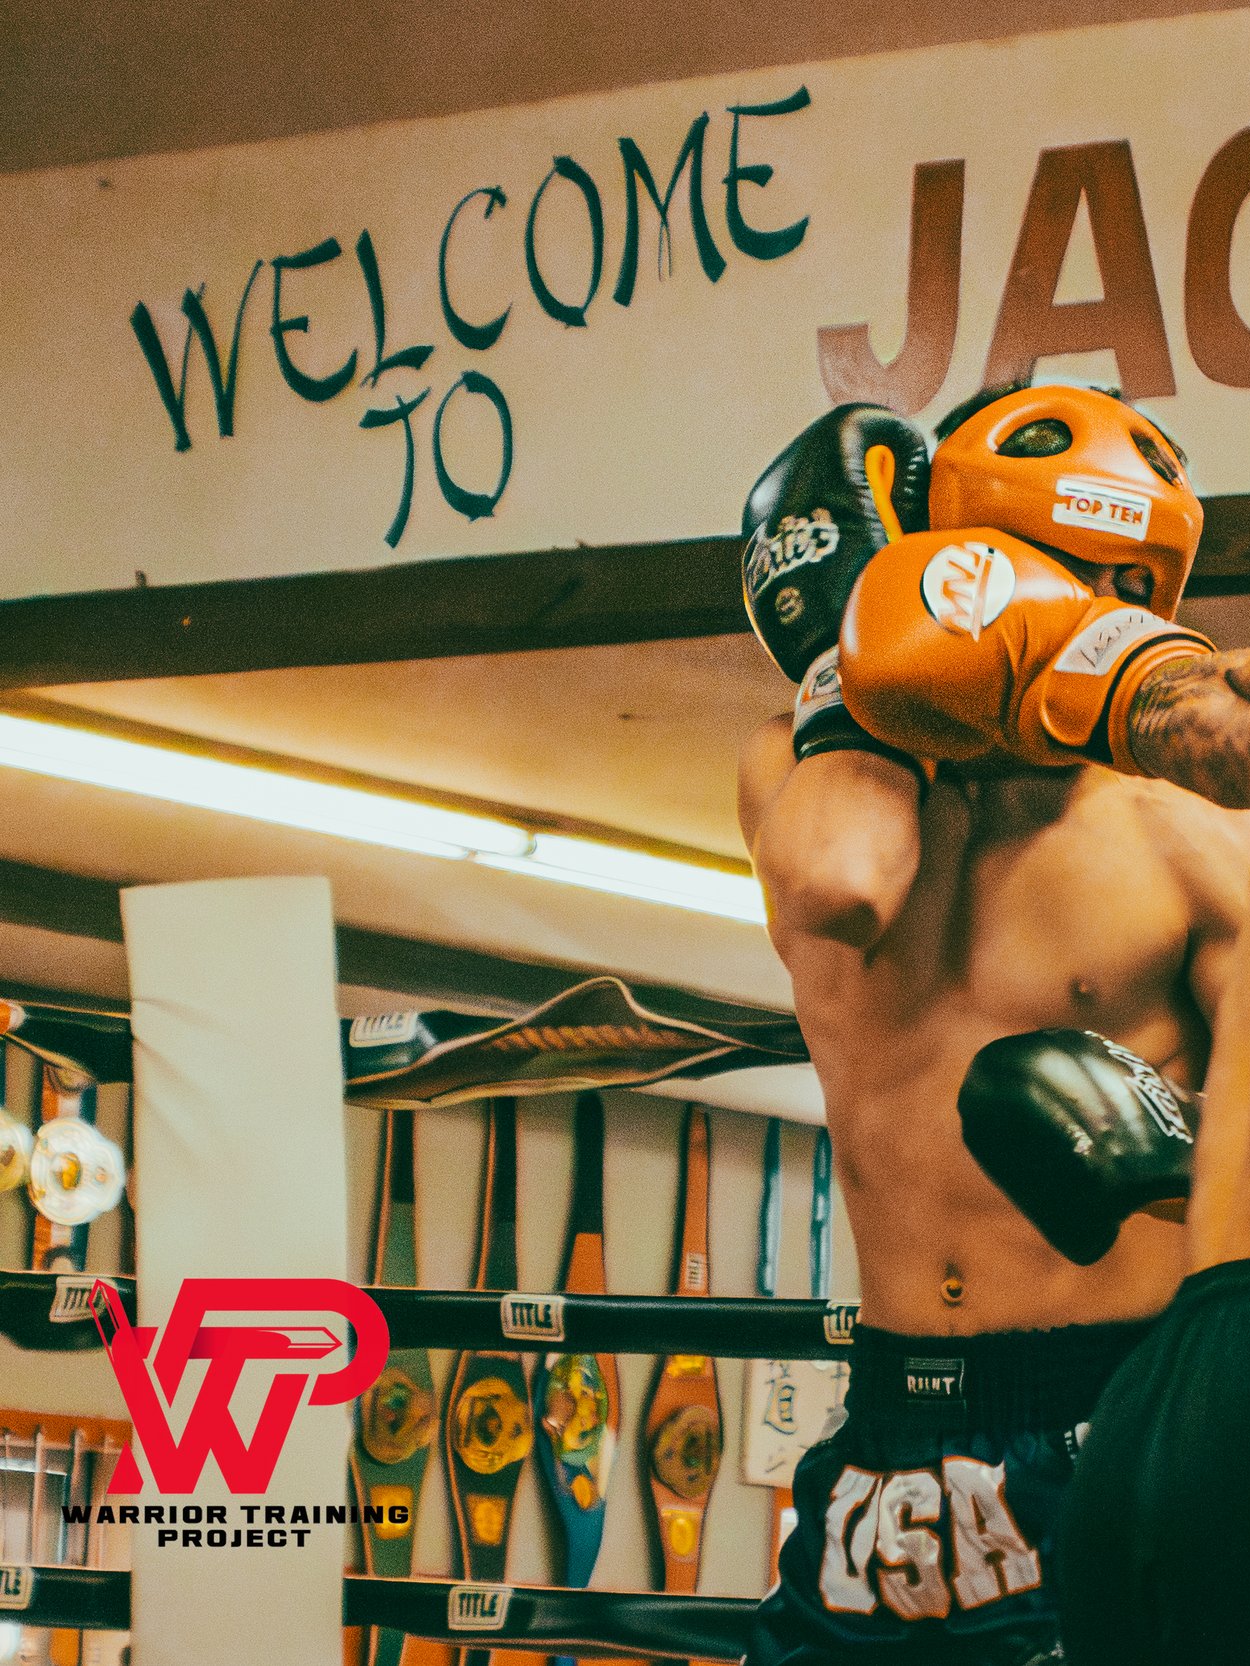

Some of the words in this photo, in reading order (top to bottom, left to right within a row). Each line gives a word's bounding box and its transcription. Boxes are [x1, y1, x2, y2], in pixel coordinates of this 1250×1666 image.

[129, 85, 811, 453] WELCOME
[359, 386, 514, 548] TO
[1062, 495, 1103, 515] TOP
[1109, 503, 1144, 524] TEN
[511, 1302, 554, 1329] TITLE
[818, 1455, 1042, 1621] USA
[458, 1592, 498, 1617] TITLE
